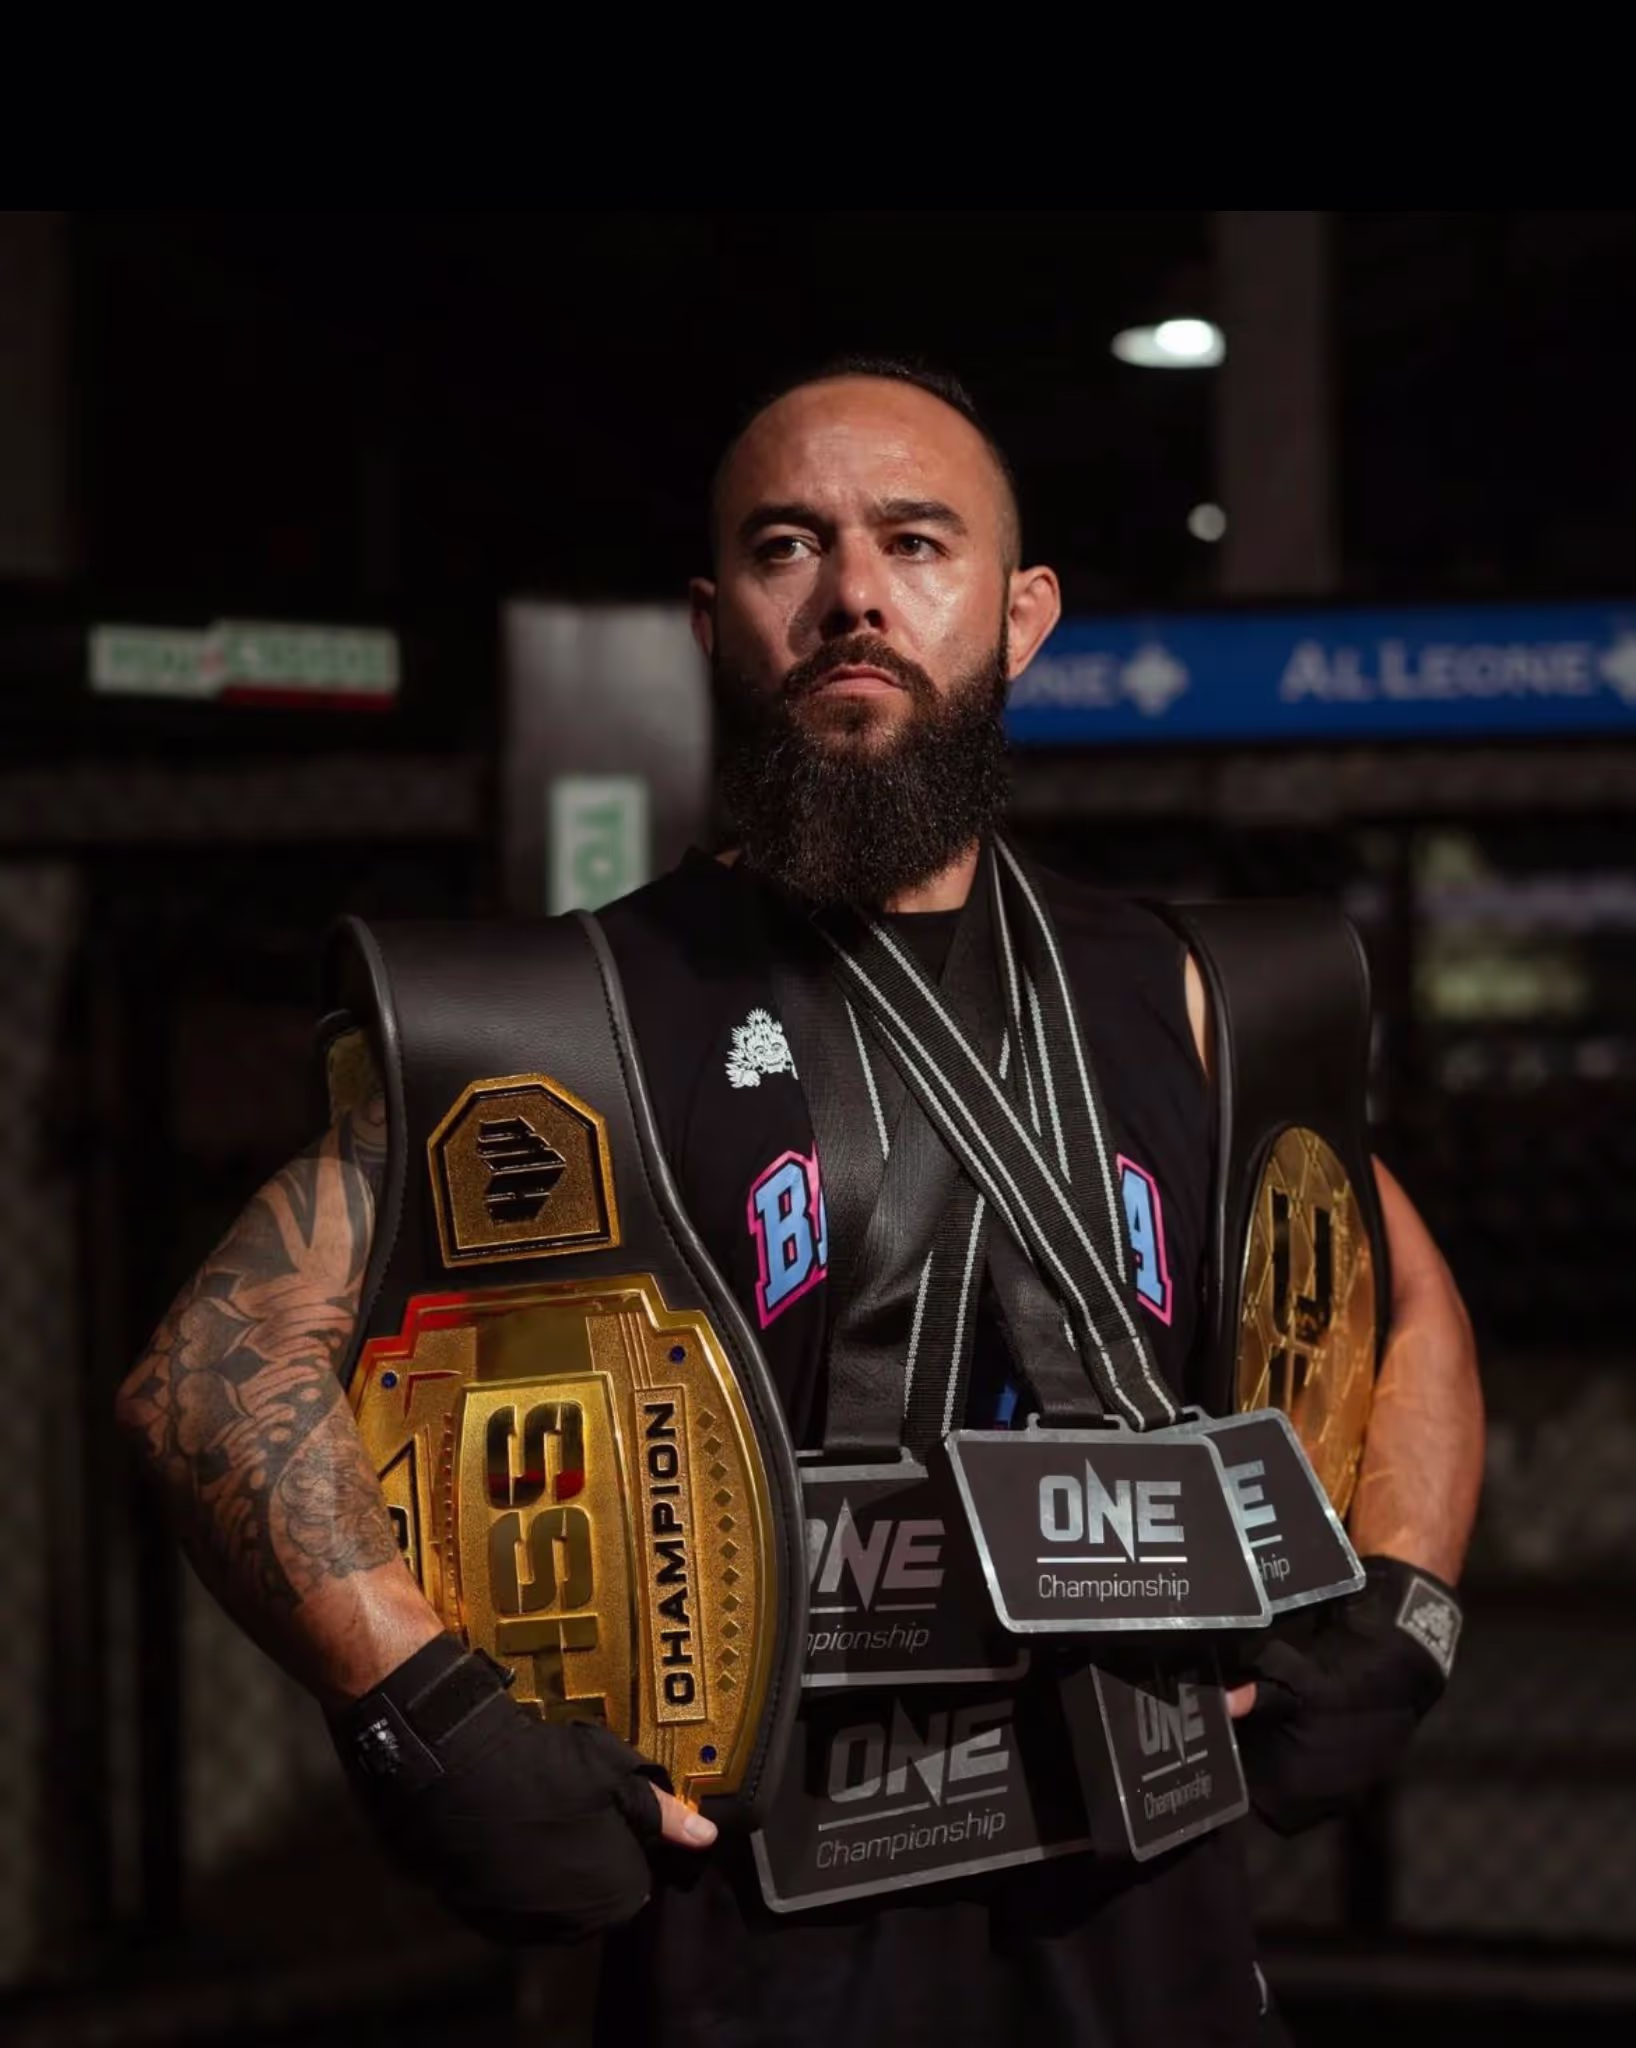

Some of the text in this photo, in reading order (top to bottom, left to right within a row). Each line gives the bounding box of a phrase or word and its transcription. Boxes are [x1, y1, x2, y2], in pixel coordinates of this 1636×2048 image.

[1378, 638, 1595, 700] LEONE
[643, 1401, 696, 1706] CHAMPION
[1038, 1457, 1185, 1563] ONE
[1038, 1573, 1189, 1602] Championship
[828, 1697, 1016, 1807] ONE
[1134, 1666, 1206, 1763] ONE
[816, 1808, 1006, 1868] Championship
